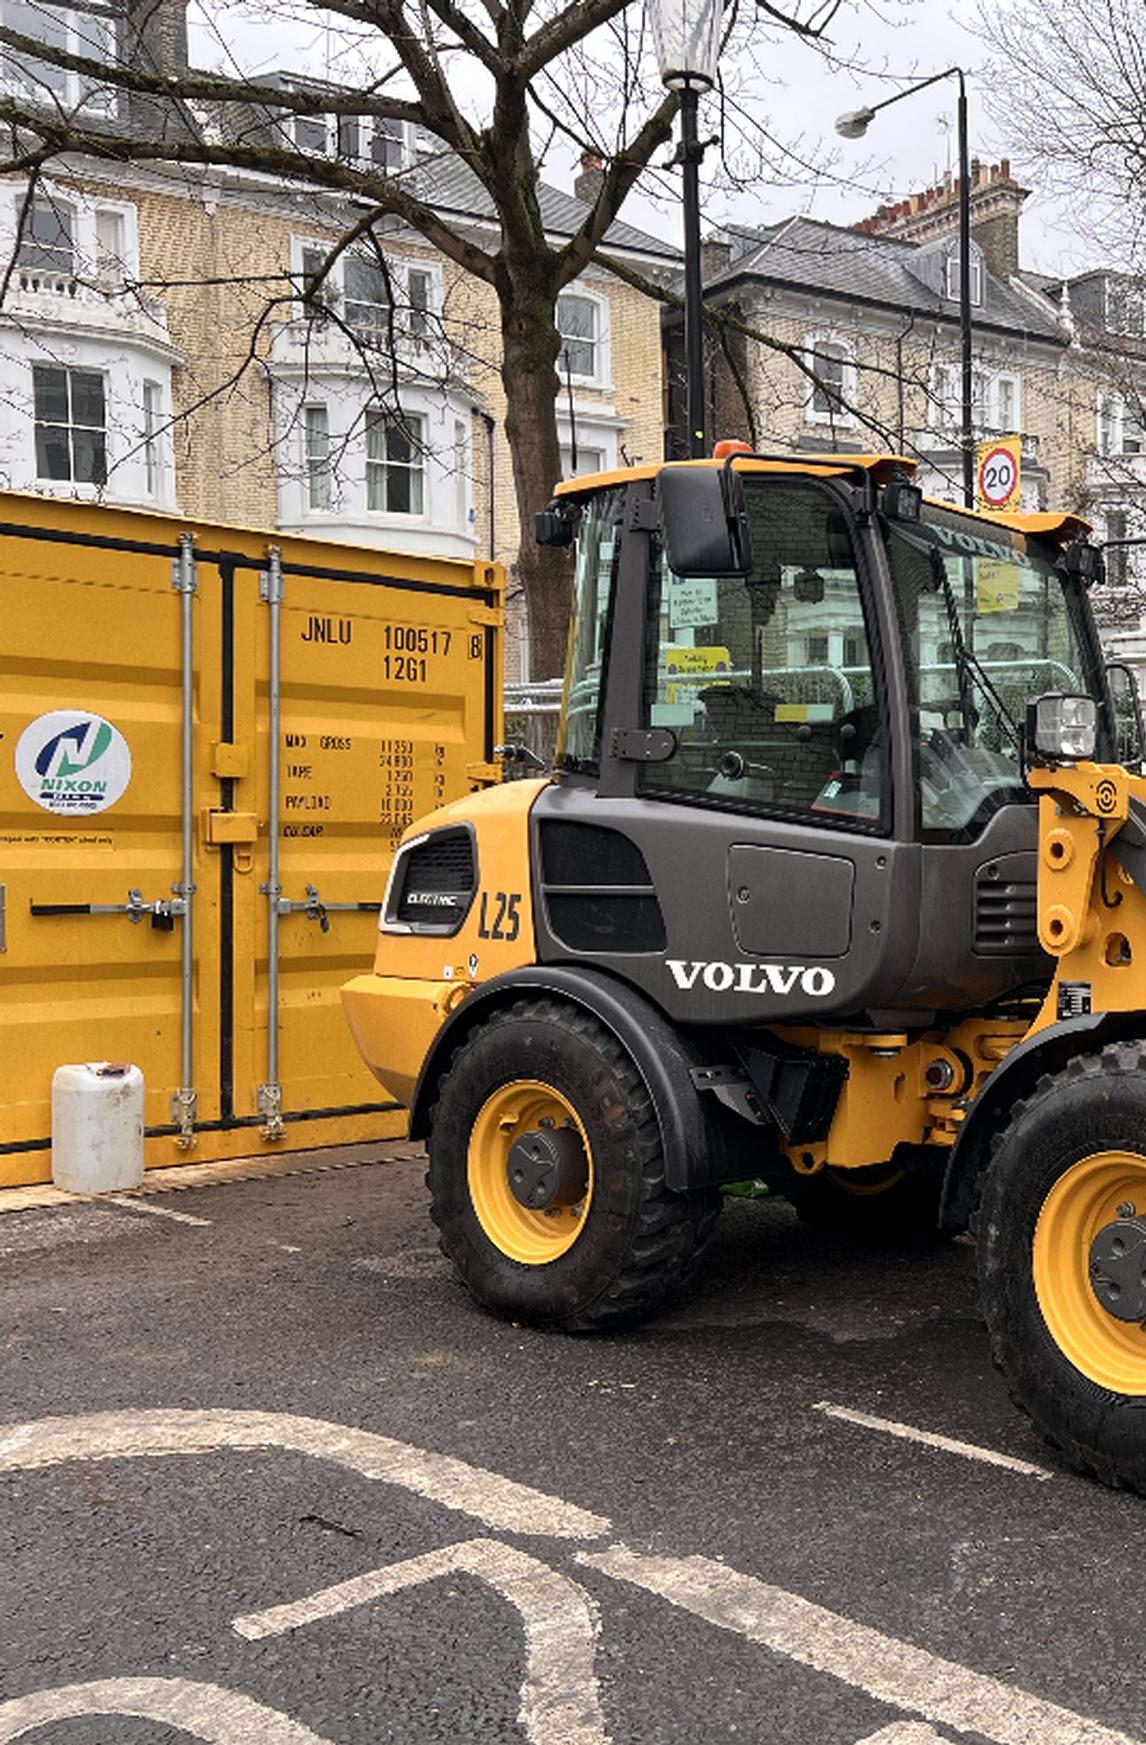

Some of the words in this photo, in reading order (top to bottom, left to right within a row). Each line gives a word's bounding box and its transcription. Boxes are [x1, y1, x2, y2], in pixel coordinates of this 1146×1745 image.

[986, 465, 1010, 489] 20
[923, 522, 1031, 568] VOLVO
[301, 616, 352, 645] JNLU
[384, 625, 452, 656] 100517
[384, 654, 427, 682] 12G1
[320, 735, 352, 750] GROSS
[40, 779, 107, 792] NIXON
[287, 765, 312, 780] TARE
[477, 891, 522, 942] L25
[665, 960, 836, 996] VOLVO
